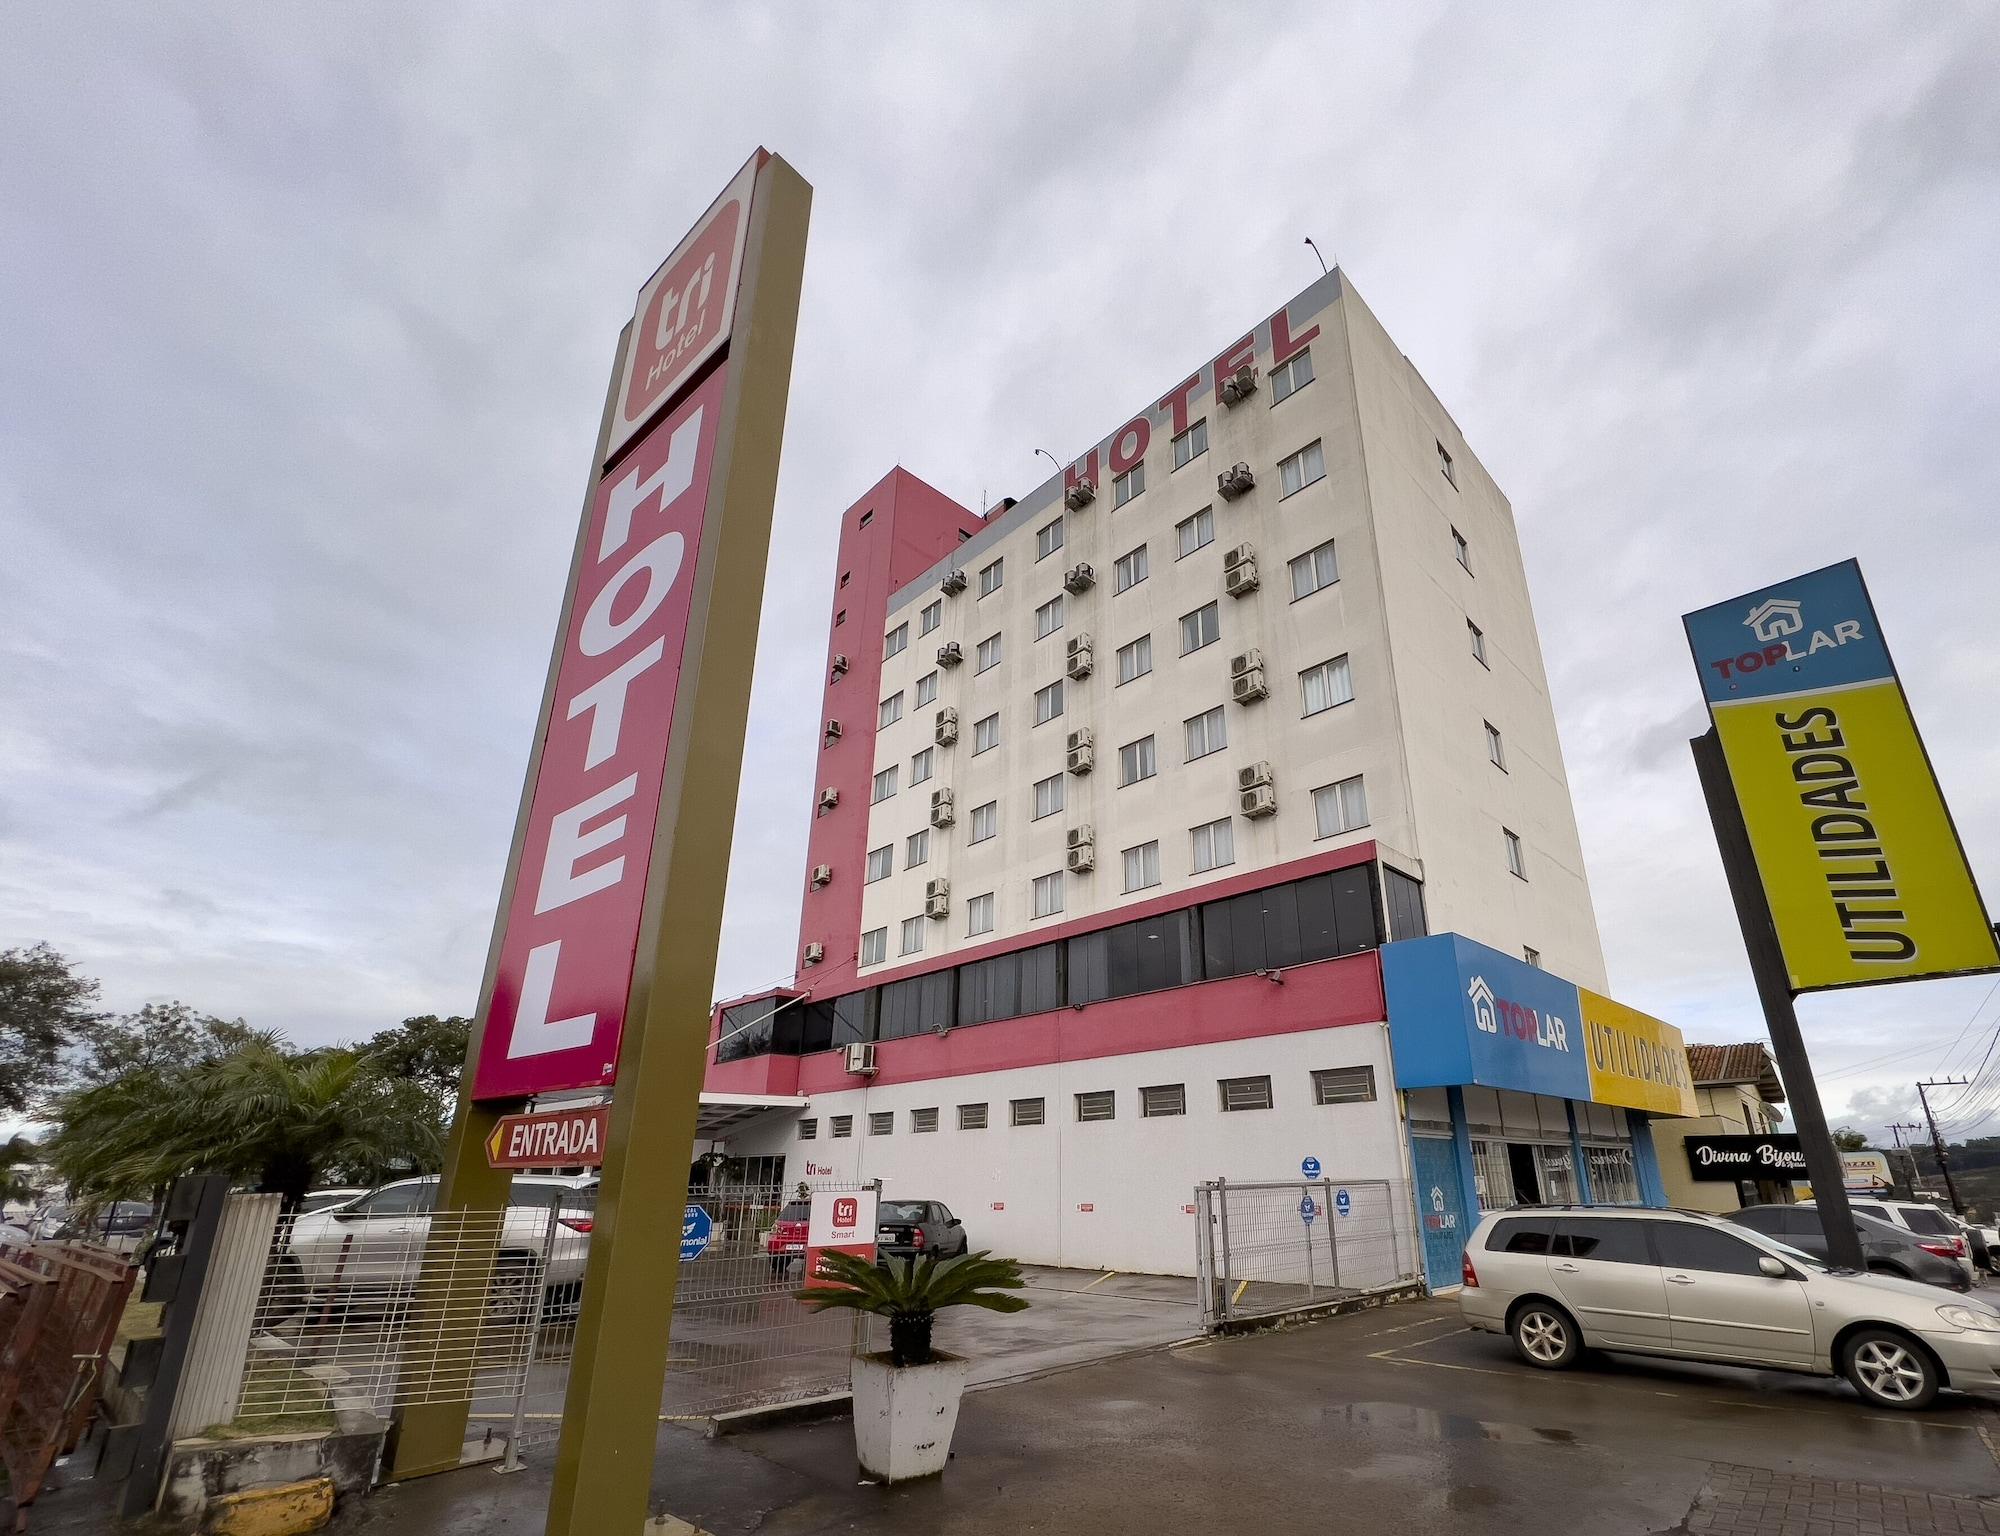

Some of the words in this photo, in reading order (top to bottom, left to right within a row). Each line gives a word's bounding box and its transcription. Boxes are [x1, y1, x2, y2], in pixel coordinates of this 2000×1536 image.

[656, 252, 715, 350] tri
[645, 309, 705, 391] Hotel
[1064, 307, 1320, 490] HOTEL
[1711, 620, 1864, 679] TOPLAR
[507, 403, 704, 1059] HOTEL
[1776, 706, 1918, 964] UTILIDADES
[1497, 998, 1569, 1053] TOPLAR
[1588, 1019, 1688, 1090] UTILIDADES
[508, 1118, 598, 1157] ENTRADA
[1696, 1145, 1751, 1165] Divina
[1756, 1144, 1805, 1168] Bijou
[806, 1160, 816, 1175] tri
[817, 1166, 833, 1175] Hotel
[831, 1231, 855, 1239] Smart
[837, 1216, 853, 1224] Hotel
[838, 1202, 853, 1217] tri
[680, 1236, 708, 1246] monial
